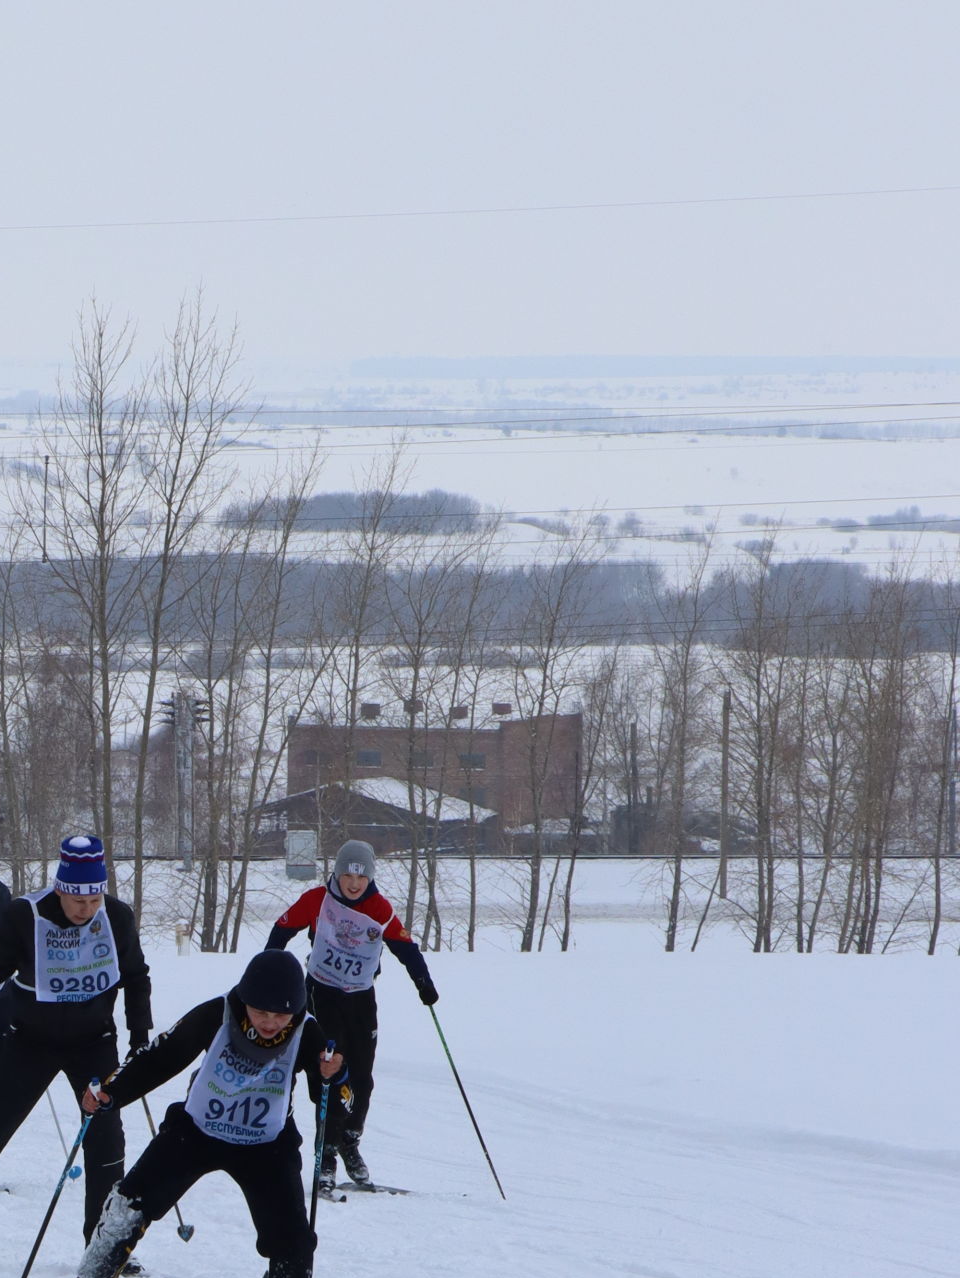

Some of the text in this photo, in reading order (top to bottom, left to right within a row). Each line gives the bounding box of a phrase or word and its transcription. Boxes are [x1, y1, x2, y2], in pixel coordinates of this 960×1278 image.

[348, 863, 366, 875] NEW
[46, 928, 80, 940] ЛЫЖНЯ
[46, 938, 80, 950] РОССИИ
[47, 949, 80, 961] 2021
[323, 949, 363, 977] 2673
[49, 970, 110, 993] 9280
[204, 1096, 271, 1129] 9112
[204, 1120, 267, 1138] РЕСПУБЛИКА
